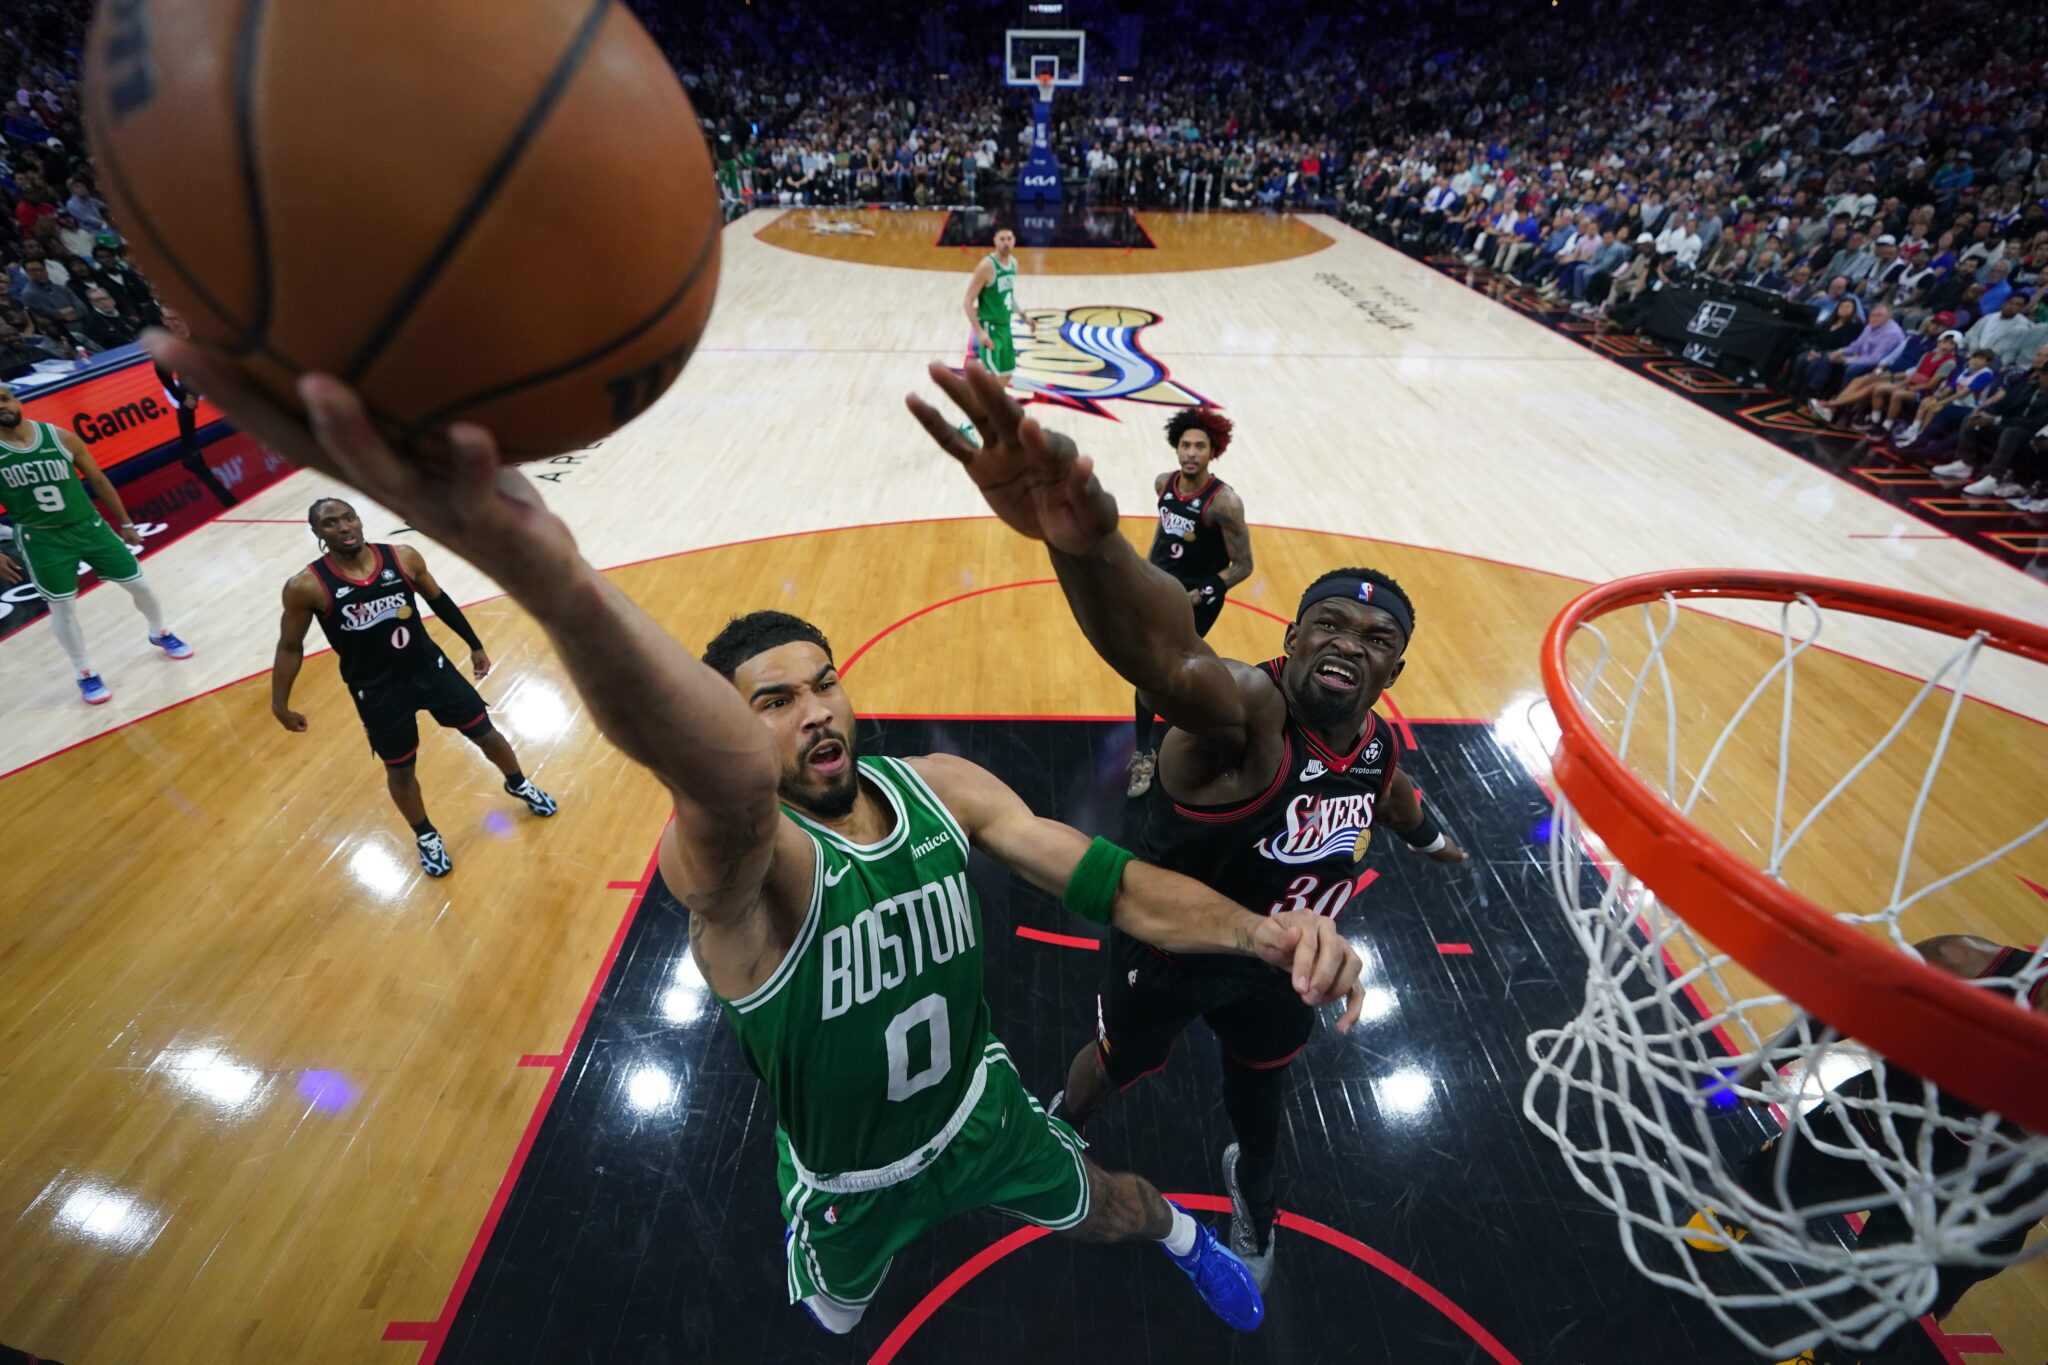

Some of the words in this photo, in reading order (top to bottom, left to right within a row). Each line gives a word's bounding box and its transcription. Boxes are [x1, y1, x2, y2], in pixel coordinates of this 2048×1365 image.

[73, 396, 169, 444] Game.
[0, 459, 71, 488] BOSTON
[33, 485, 66, 512] 9
[1170, 542, 1184, 559] 9
[341, 592, 407, 631] SIXERS
[391, 626, 411, 650] 0
[1306, 759, 1323, 773] NIKE
[1349, 766, 1382, 775] crypto.com
[1254, 793, 1376, 860] SIXERS
[1268, 874, 1359, 921] 30
[822, 871, 976, 1021] BOSTON
[884, 993, 951, 1102] 0
